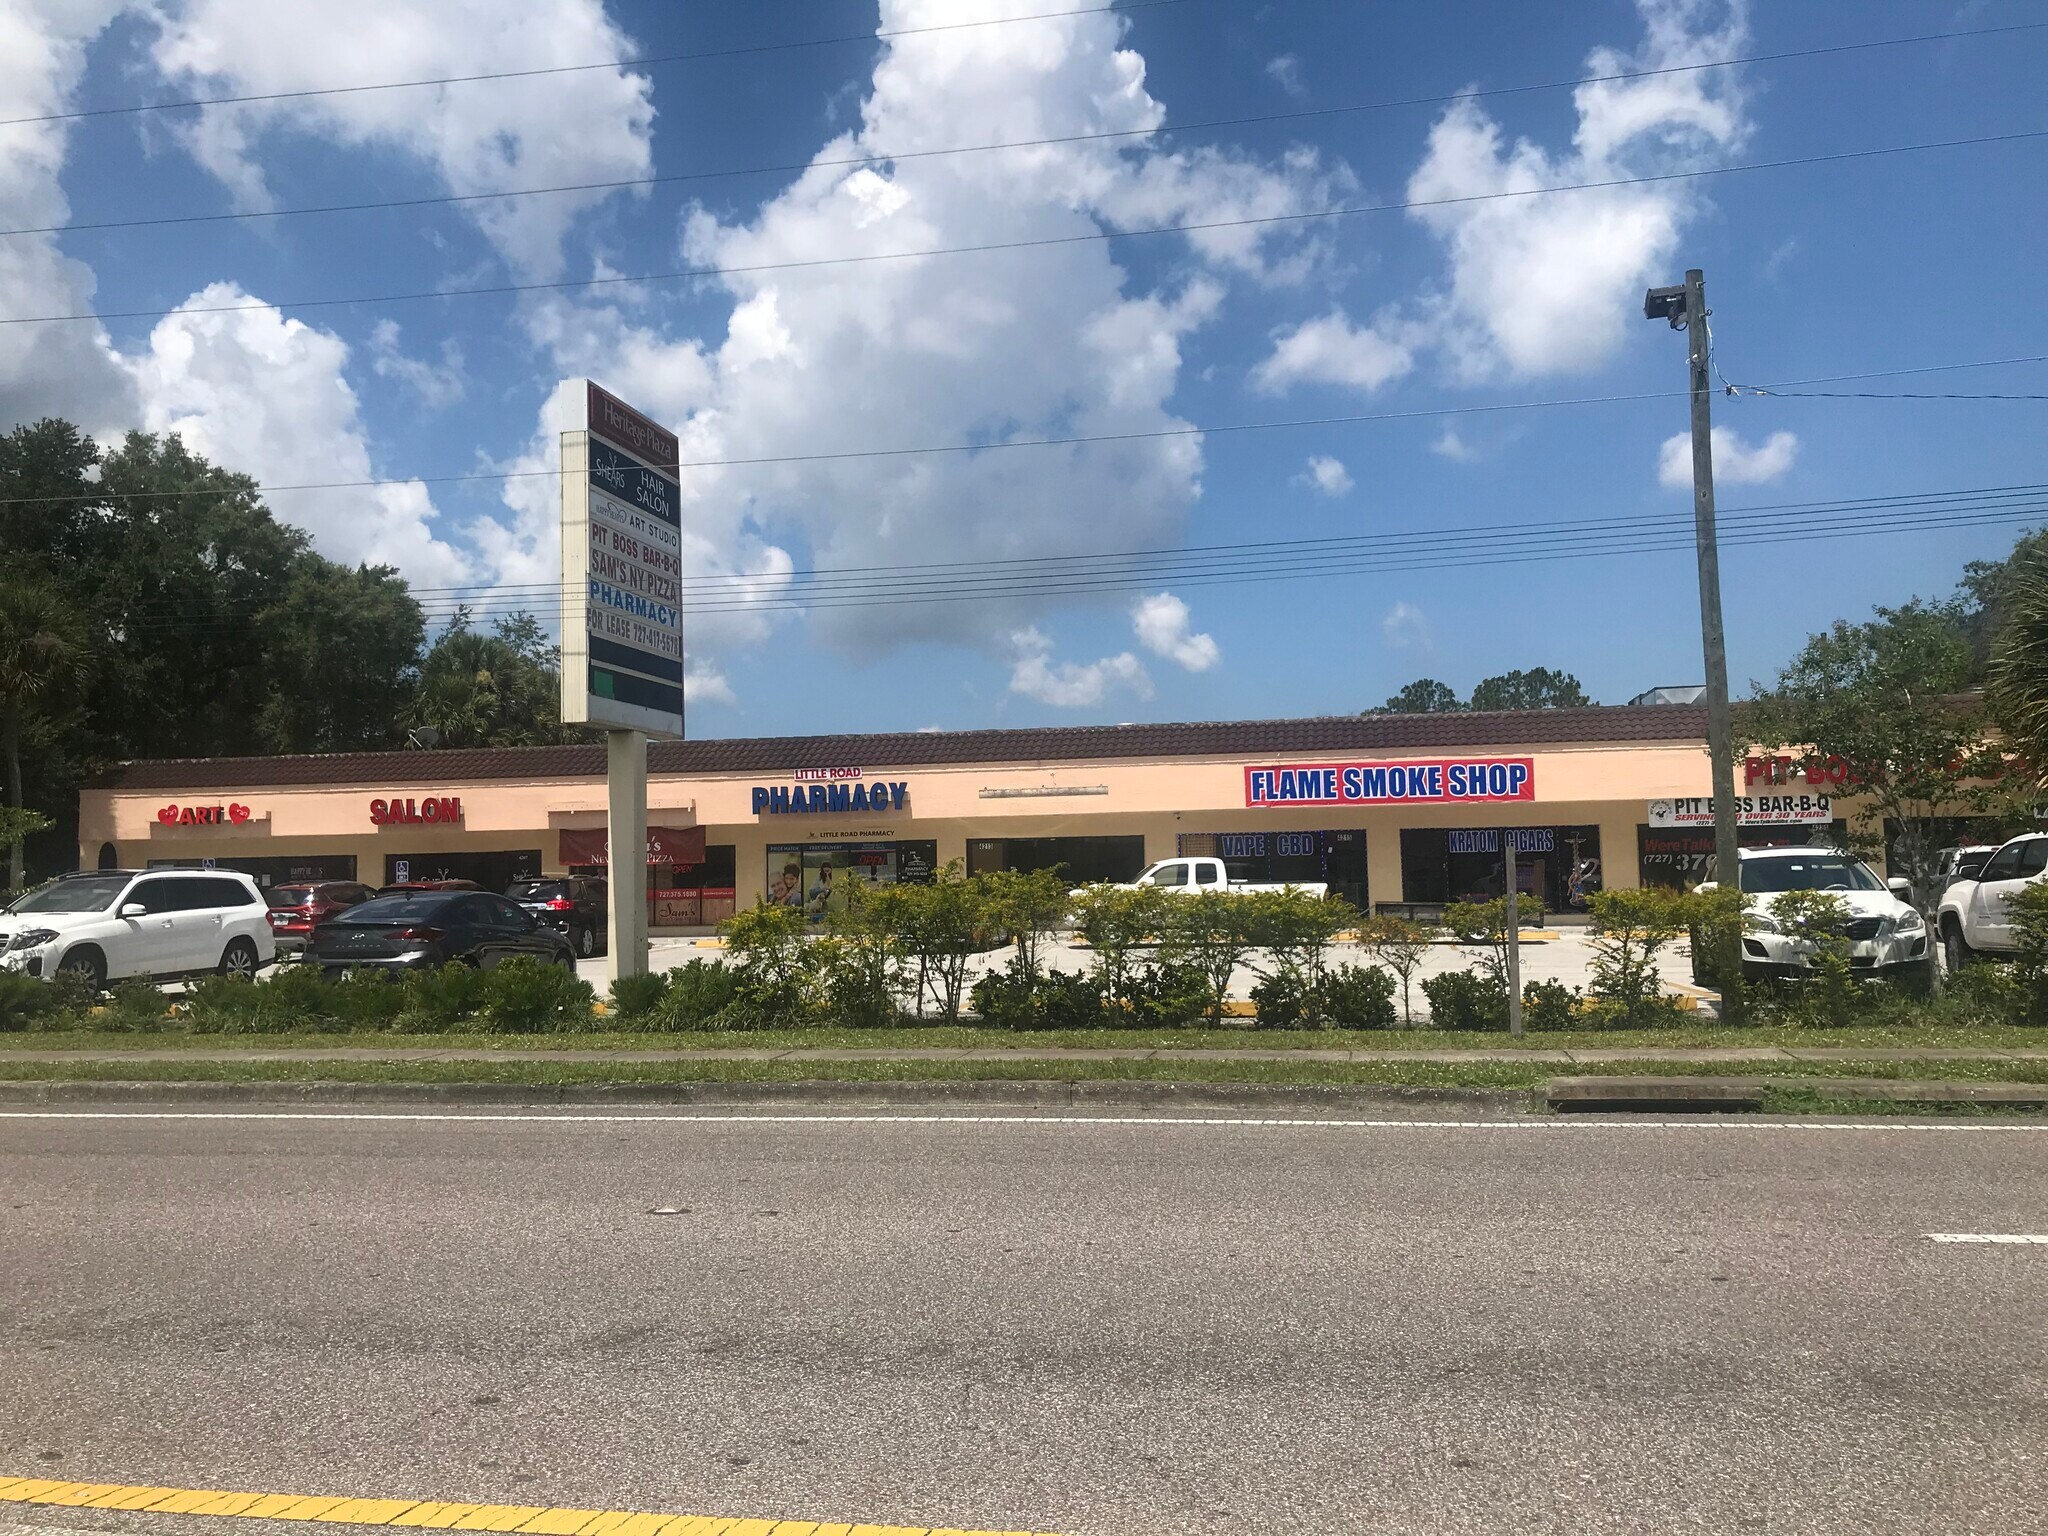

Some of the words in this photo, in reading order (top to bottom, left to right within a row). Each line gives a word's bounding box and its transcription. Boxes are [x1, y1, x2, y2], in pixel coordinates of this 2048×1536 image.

[604, 401, 646, 446] Heritage
[647, 427, 671, 460] Plaza
[596, 458, 625, 488] SHEARS
[641, 471, 665, 497] HAIR
[637, 486, 669, 517] SALON
[630, 515, 645, 531] ART
[649, 524, 676, 547] STUDIO
[592, 523, 607, 545] PIT
[613, 532, 638, 559] BOSS
[643, 545, 679, 577] BAR-B-Q
[592, 549, 626, 583] SAM'S
[630, 566, 644, 590] NY
[648, 573, 676, 604] PIZZA
[590, 580, 676, 627] PHARMACY
[587, 607, 603, 630] FOR
[606, 614, 630, 639] LEASE
[795, 769, 827, 780] LITTLE
[830, 767, 861, 778] ROAD
[1251, 769, 1337, 801] FLAME
[1343, 766, 1443, 798] SMOKE
[1449, 763, 1527, 796] SHOP
[1745, 755, 1791, 786] PIT
[369, 797, 461, 826] SALON
[752, 781, 908, 815] PHARMACY
[1674, 797, 1701, 814] PIT
[1707, 796, 1753, 814] BSS
[1758, 795, 1830, 812] BAR-B-Q
[179, 807, 223, 825] ART
[1744, 811, 1772, 819] OVER
[1775, 811, 1791, 819] 30
[1794, 810, 1827, 818] YEARS
[1221, 834, 1264, 857] VAPE
[1277, 834, 1313, 856] CBD
[1449, 830, 1498, 853] KRATOM
[1505, 828, 1554, 853] CIGARS
[647, 853, 674, 863] PIZZA
[673, 865, 692, 874] OPEN
[859, 855, 885, 865] OPEN
[1644, 854, 1673, 865] (727)
[659, 902, 696, 917] Sam's
